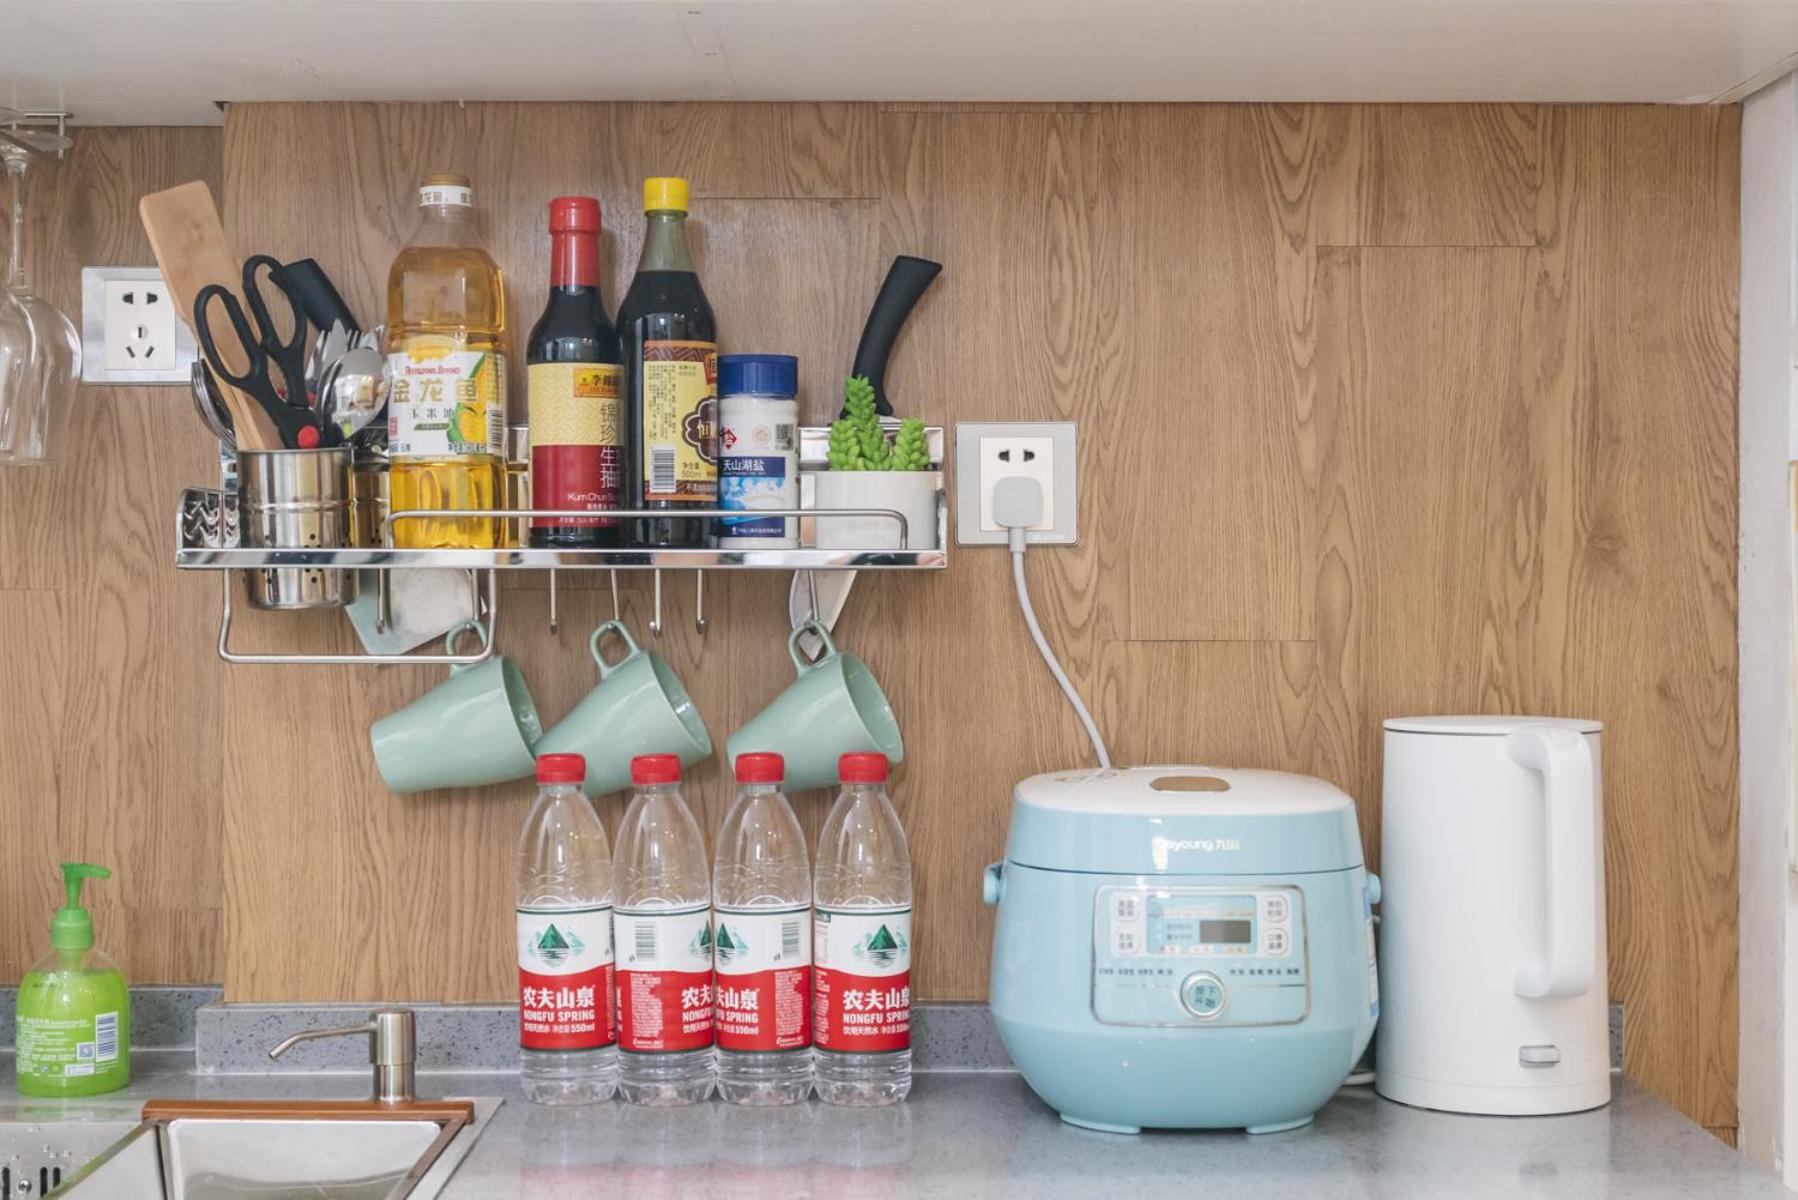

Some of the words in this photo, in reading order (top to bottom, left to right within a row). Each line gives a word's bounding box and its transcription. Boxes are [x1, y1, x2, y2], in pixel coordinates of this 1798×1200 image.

[393, 379, 478, 403] 金龙鱼
[600, 404, 618, 488] 锦珍生抽
[723, 458, 766, 472] 天山湖盐
[524, 986, 595, 1009] 农夫山泉
[558, 1010, 596, 1022] SPRING
[726, 1011, 759, 1023] SPRING
[843, 1012, 883, 1024] NONGFU
